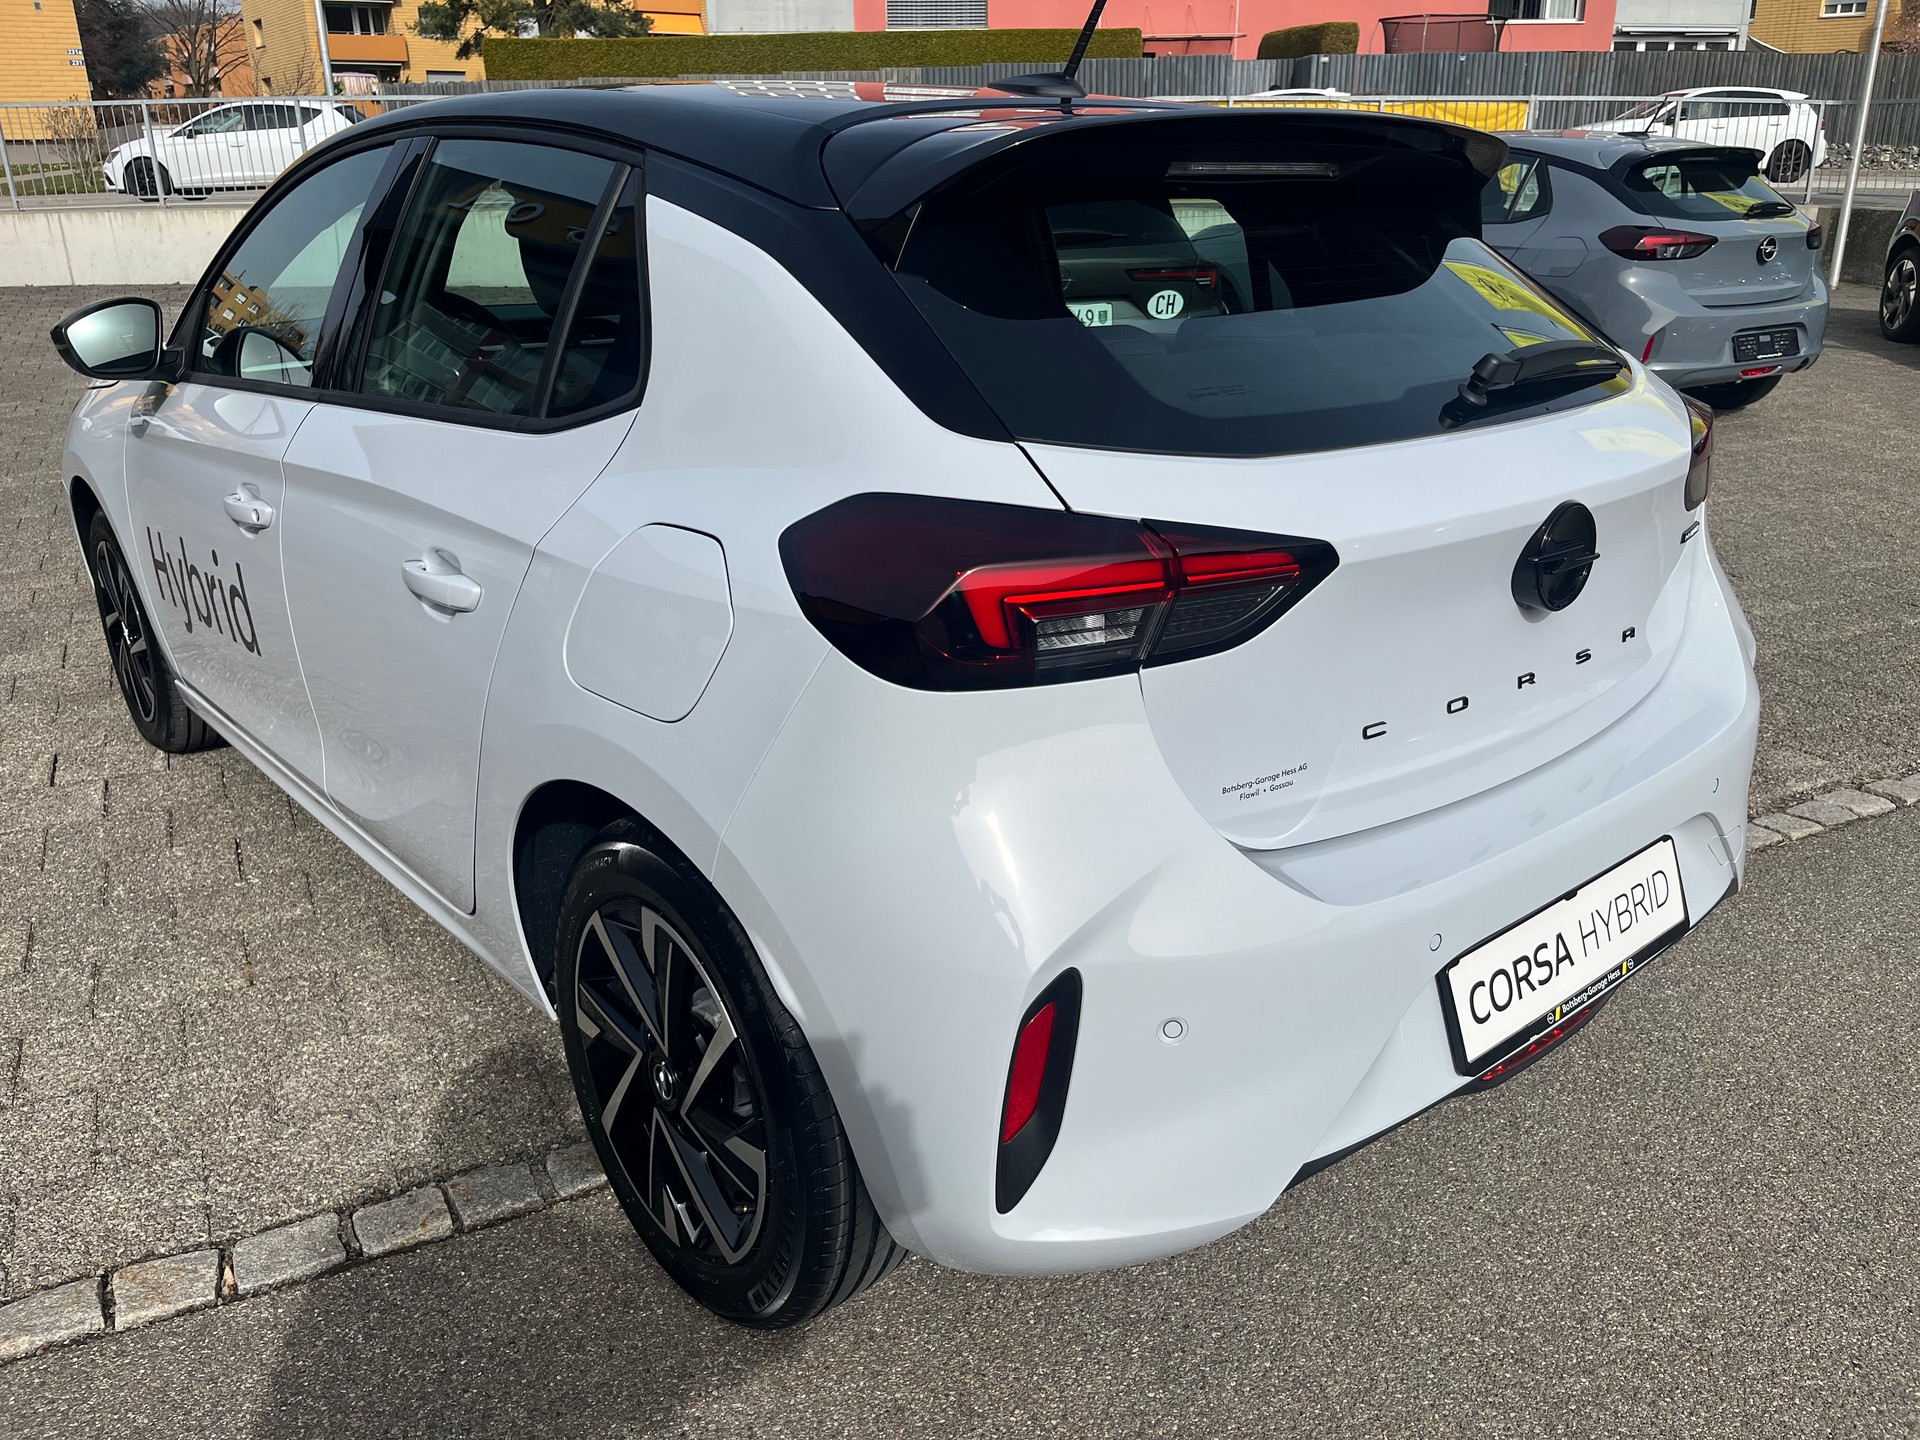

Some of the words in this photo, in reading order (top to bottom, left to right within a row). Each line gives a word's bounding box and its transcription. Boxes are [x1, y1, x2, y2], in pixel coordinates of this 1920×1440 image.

[1155, 294, 1177, 315] CH
[146, 526, 262, 657] Hybrid
[1362, 626, 1636, 740] CORSA
[1222, 773, 1280, 795] Botsberg-Garage
[1281, 767, 1297, 778] Hess
[1298, 763, 1308, 772] AG
[1239, 788, 1260, 801] Flawil
[1269, 780, 1294, 792] Gossau
[1469, 931, 1575, 1025] CORSA
[1578, 870, 1669, 958] HYBRID
[1561, 975, 1608, 1014] Botsberg-Garage
[1607, 968, 1621, 983] Hess
